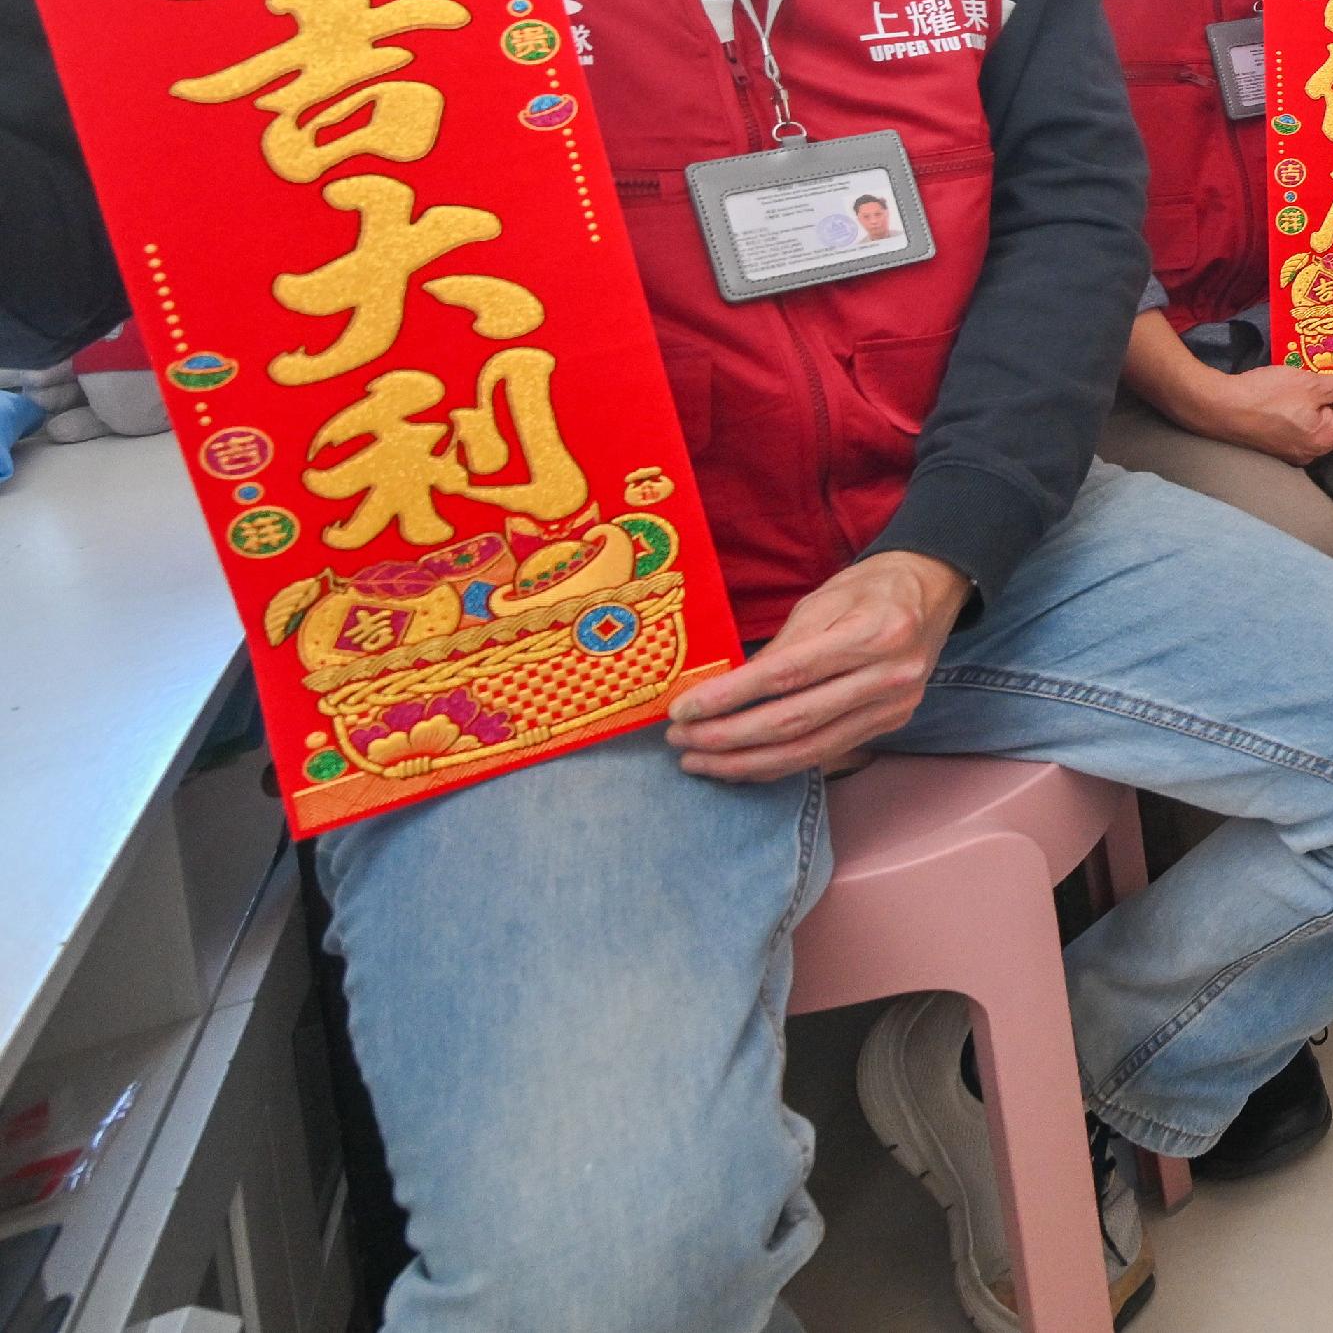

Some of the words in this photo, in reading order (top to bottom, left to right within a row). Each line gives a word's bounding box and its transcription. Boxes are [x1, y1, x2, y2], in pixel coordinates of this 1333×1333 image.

[869, 40, 930, 62] UPPER
[930, 36, 962, 54] YIU
[343, 606, 395, 652] 吉
